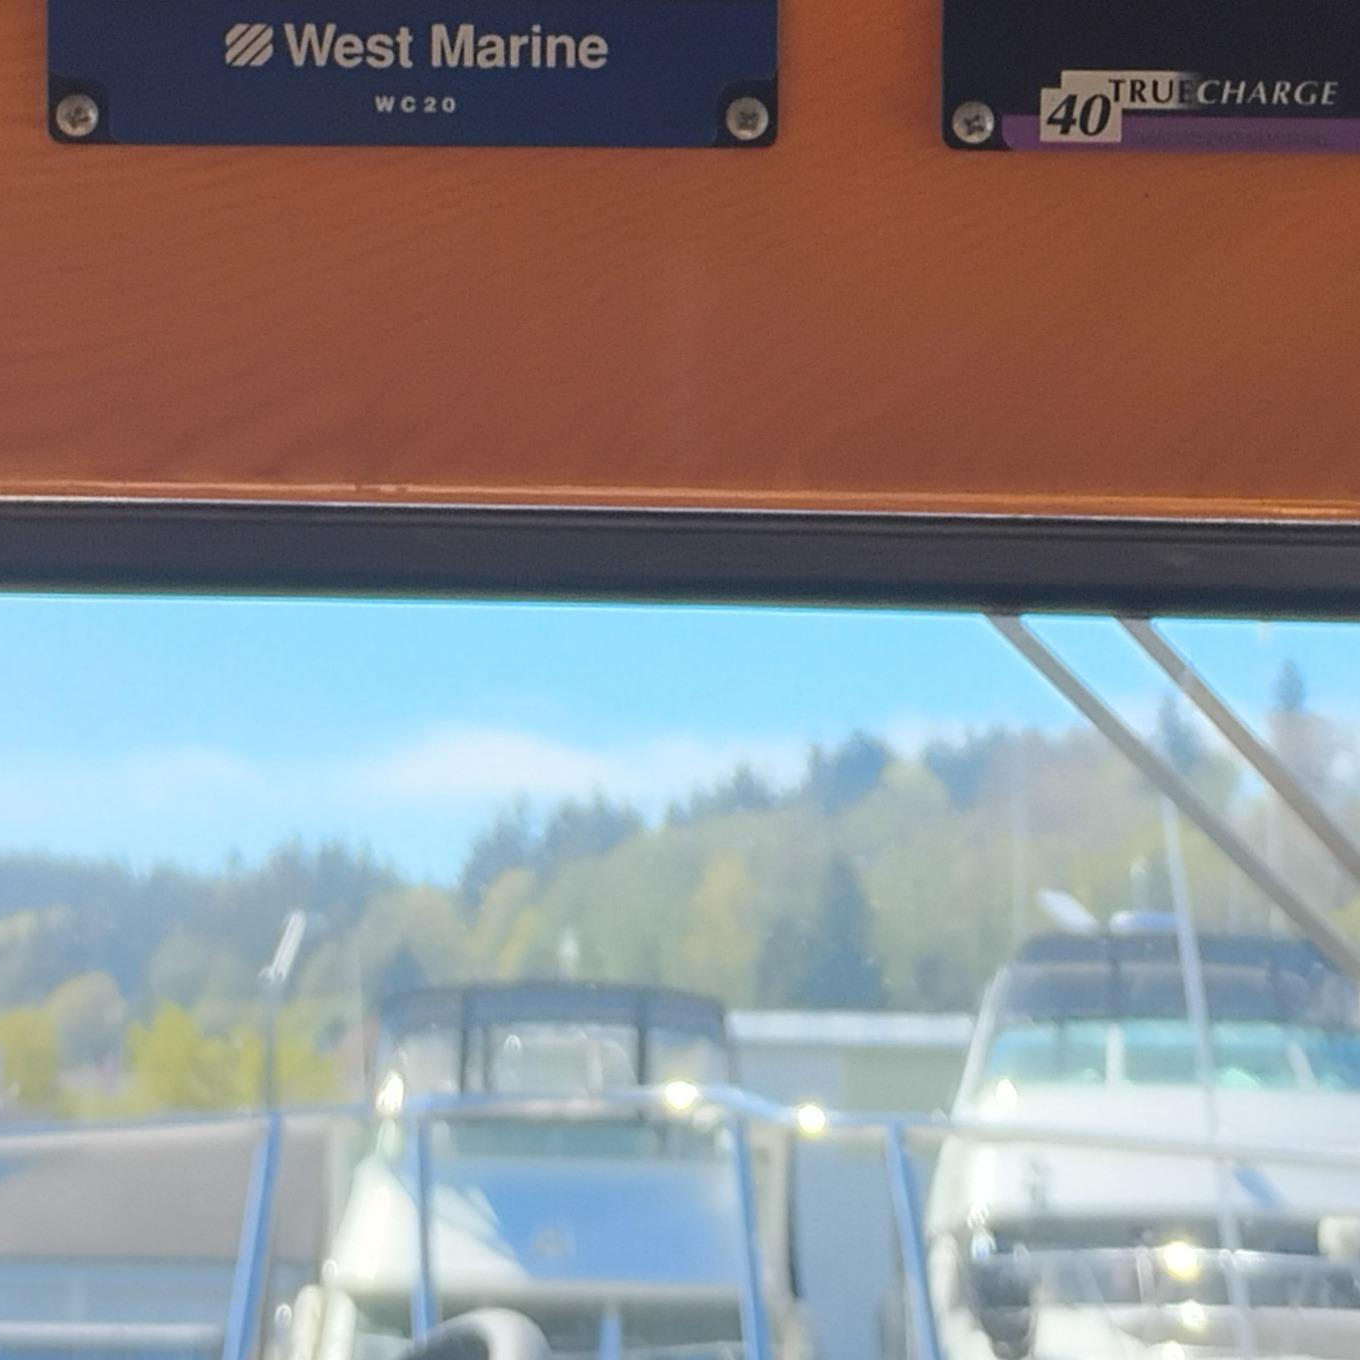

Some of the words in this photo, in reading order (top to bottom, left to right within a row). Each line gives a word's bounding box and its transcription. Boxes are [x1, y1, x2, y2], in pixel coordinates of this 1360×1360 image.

[284, 23, 413, 68] West
[431, 24, 608, 69] Marine
[1047, 92, 1113, 136] 40
